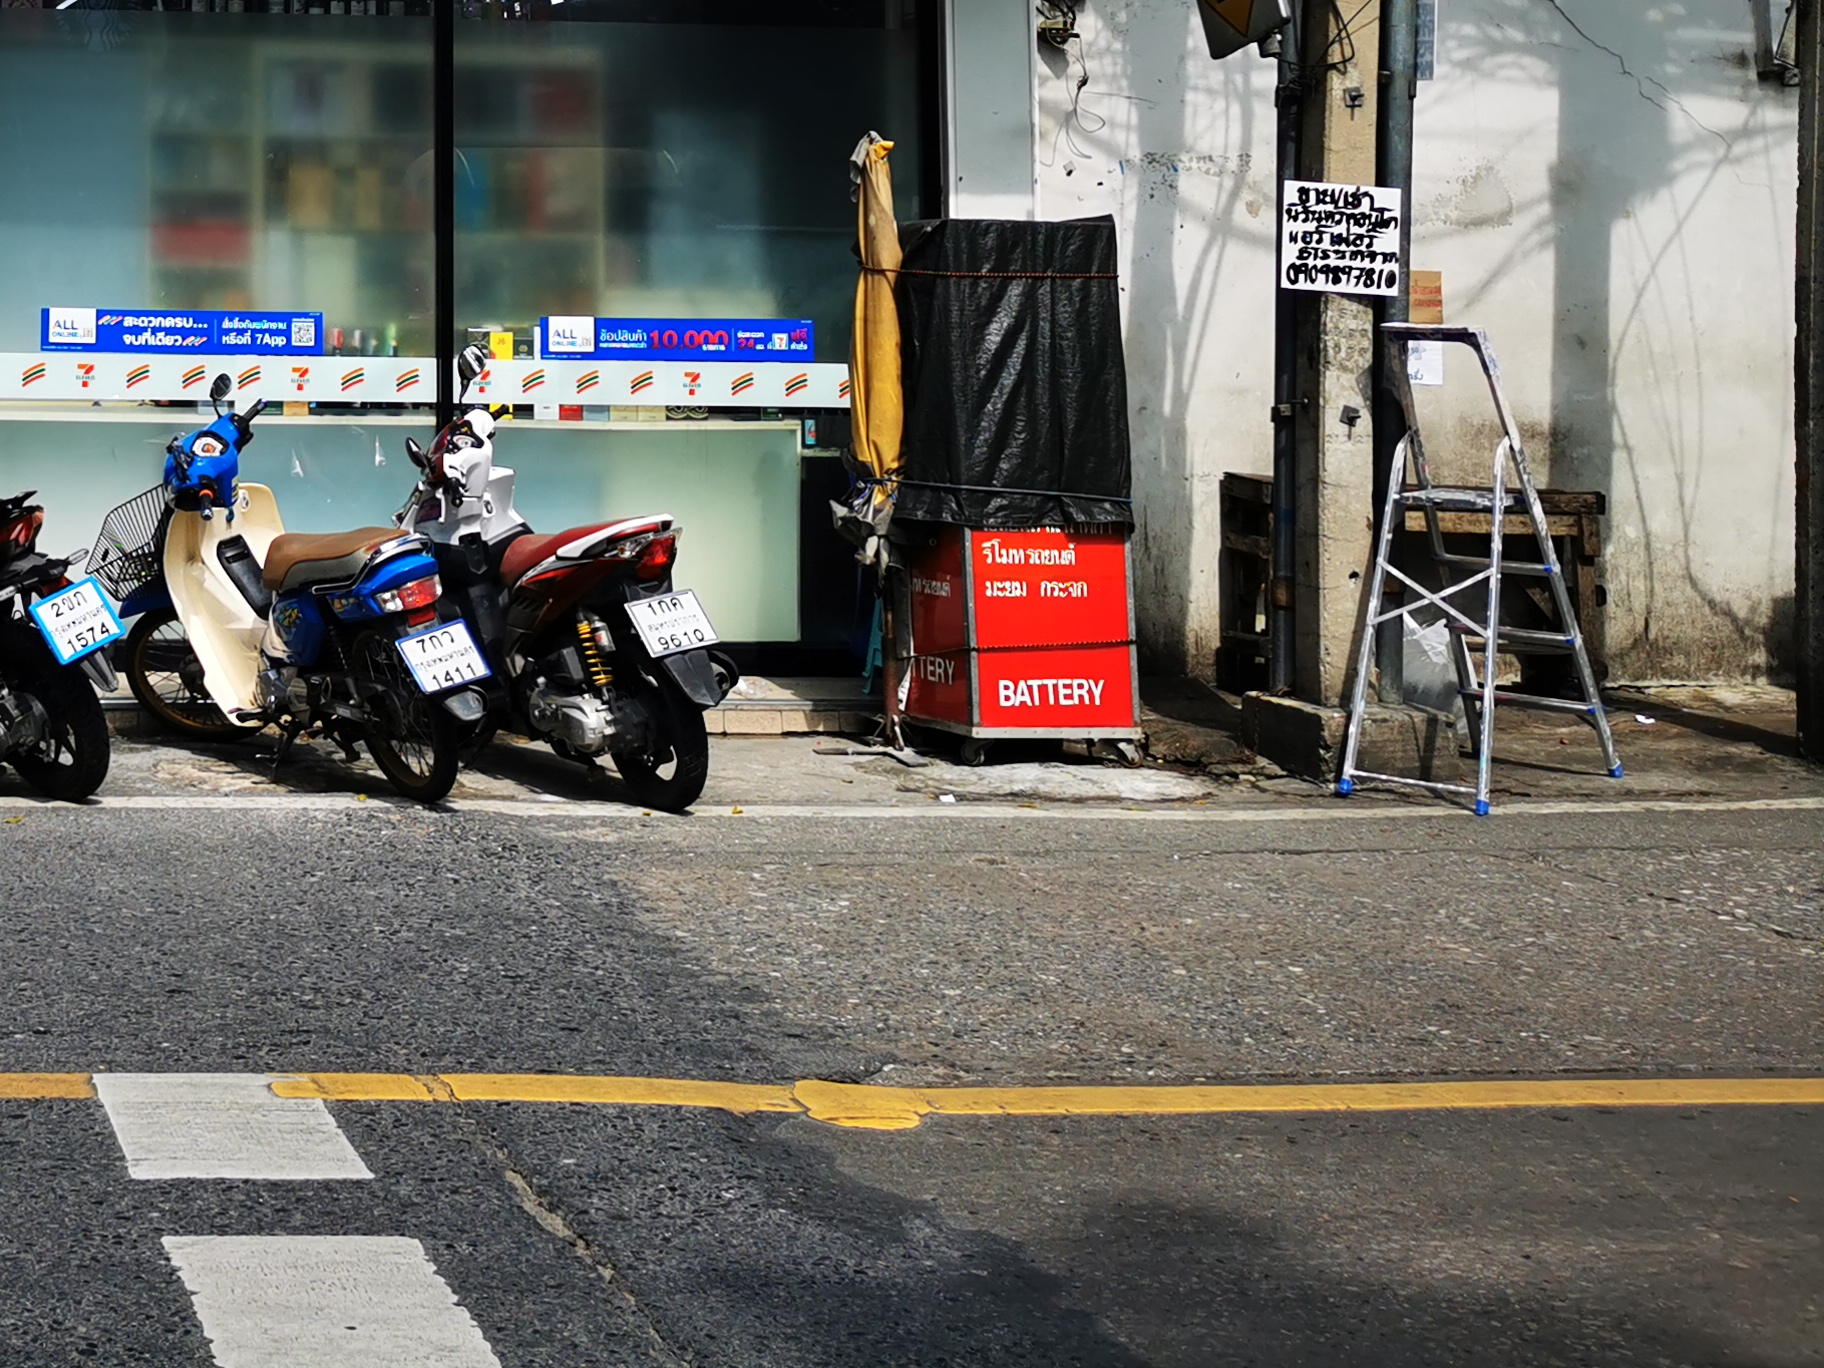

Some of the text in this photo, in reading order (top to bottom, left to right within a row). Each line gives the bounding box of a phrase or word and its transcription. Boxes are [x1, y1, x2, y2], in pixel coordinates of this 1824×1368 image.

[53, 319, 79, 330] ALL
[552, 329, 578, 339] ALL
[222, 329, 287, 347] หรือที่ 7App
[650, 330, 729, 350] 10,000
[77, 364, 95, 388] 7
[291, 367, 309, 391] 7
[684, 372, 701, 395] 7
[981, 539, 1076, 566] รีโมท รถยนต์
[1040, 580, 1088, 598] กระจก
[66, 621, 111, 653] 1574
[415, 631, 455, 653] 7กว
[657, 628, 705, 651] 9610
[415, 645, 475, 672] กรุงเทพมหานคร
[432, 662, 477, 690] 1411
[998, 679, 1105, 707] BATTERY
